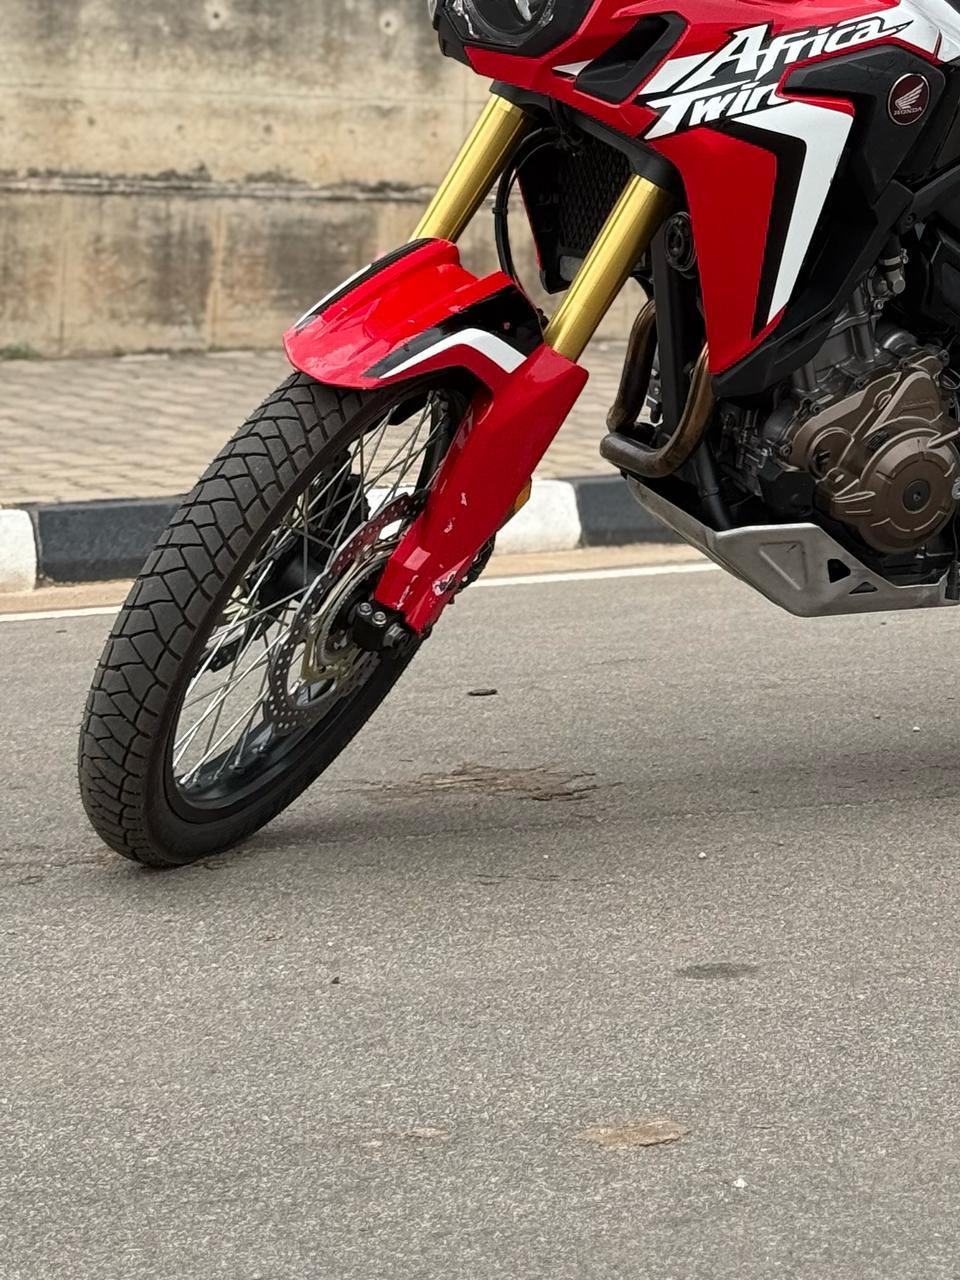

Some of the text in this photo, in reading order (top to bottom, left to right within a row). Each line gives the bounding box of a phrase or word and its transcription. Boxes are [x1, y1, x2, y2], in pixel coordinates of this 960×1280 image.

[672, 21, 909, 94] Africa
[645, 79, 789, 140] Twin
[893, 106, 922, 116] HONDA
